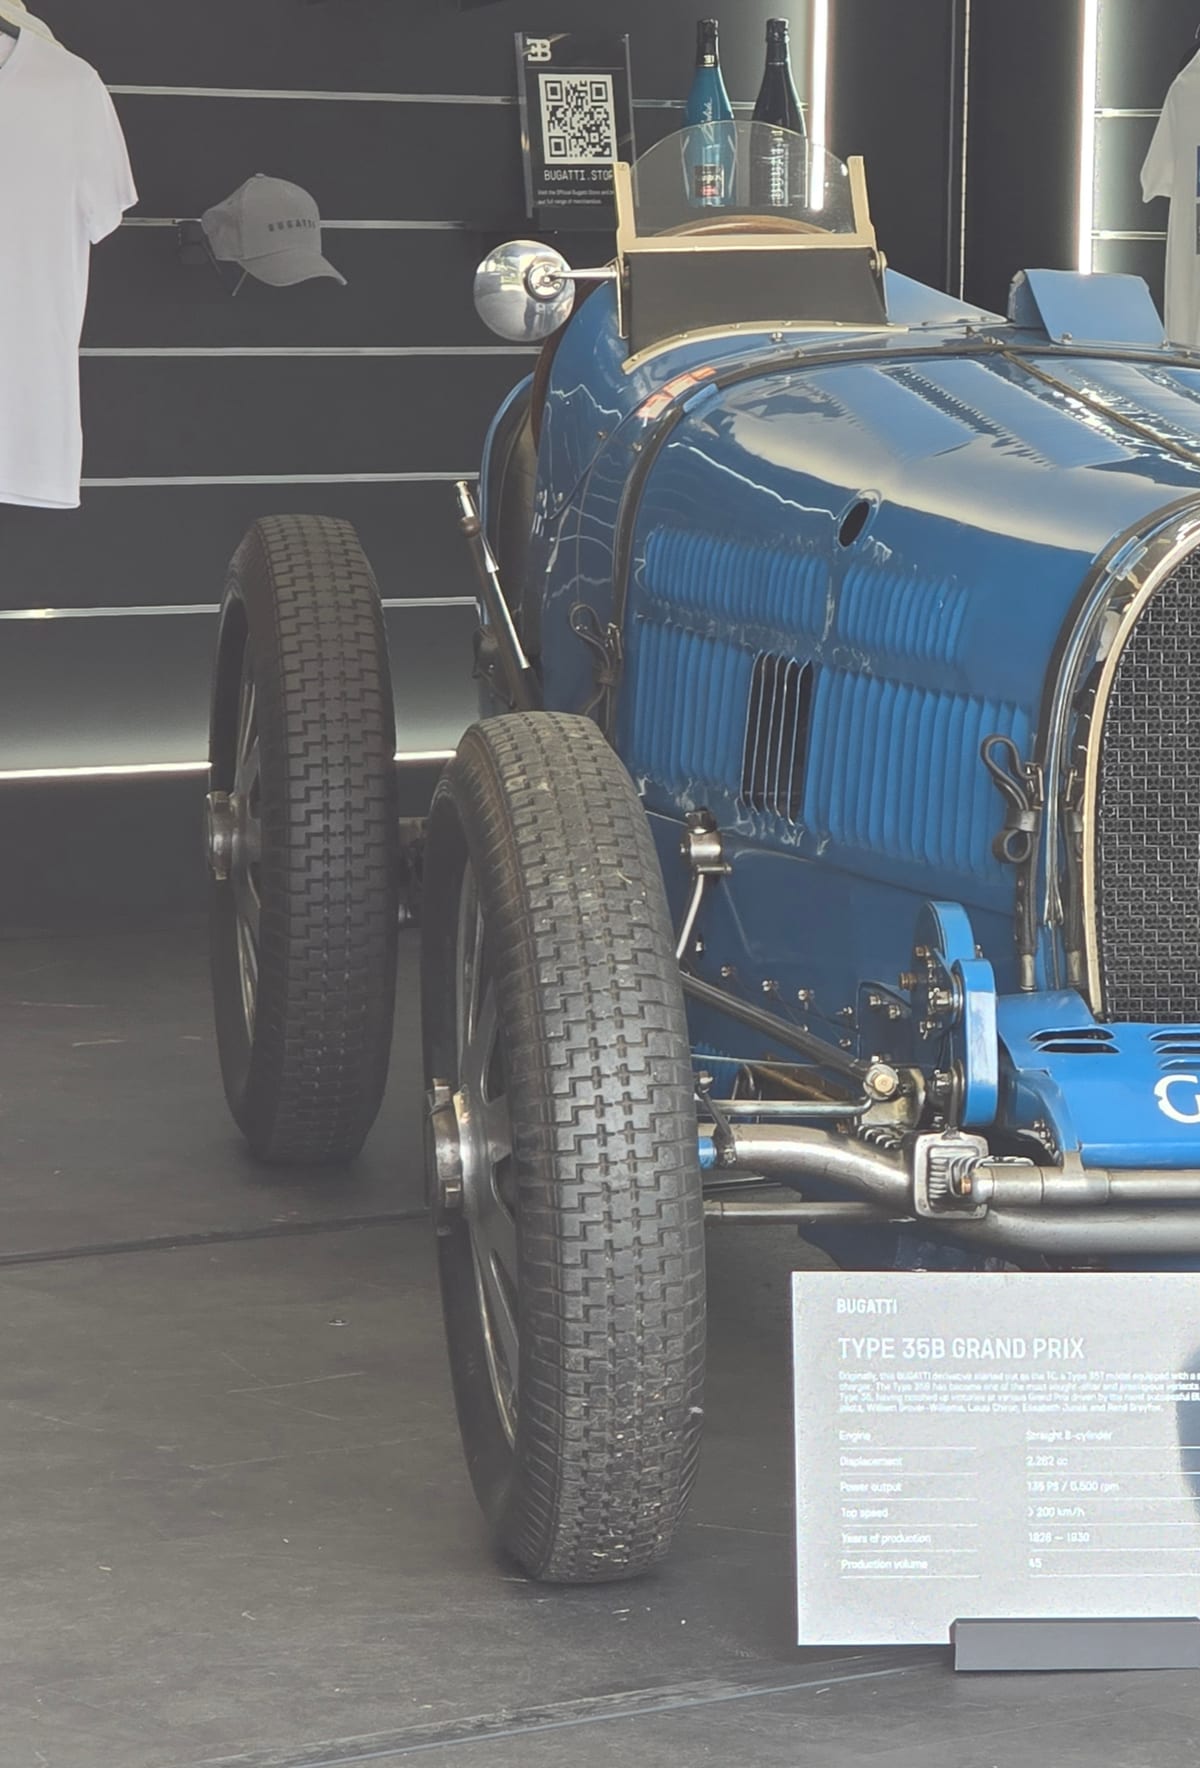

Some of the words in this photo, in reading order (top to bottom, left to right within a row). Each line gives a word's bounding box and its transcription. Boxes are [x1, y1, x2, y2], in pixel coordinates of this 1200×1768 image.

[836, 1299, 897, 1314] BUGATTI
[838, 1337, 895, 1360] TYPE
[901, 1337, 946, 1360] 35B
[951, 1337, 1027, 1360] GRAND
[1032, 1337, 1085, 1360] PRIX
